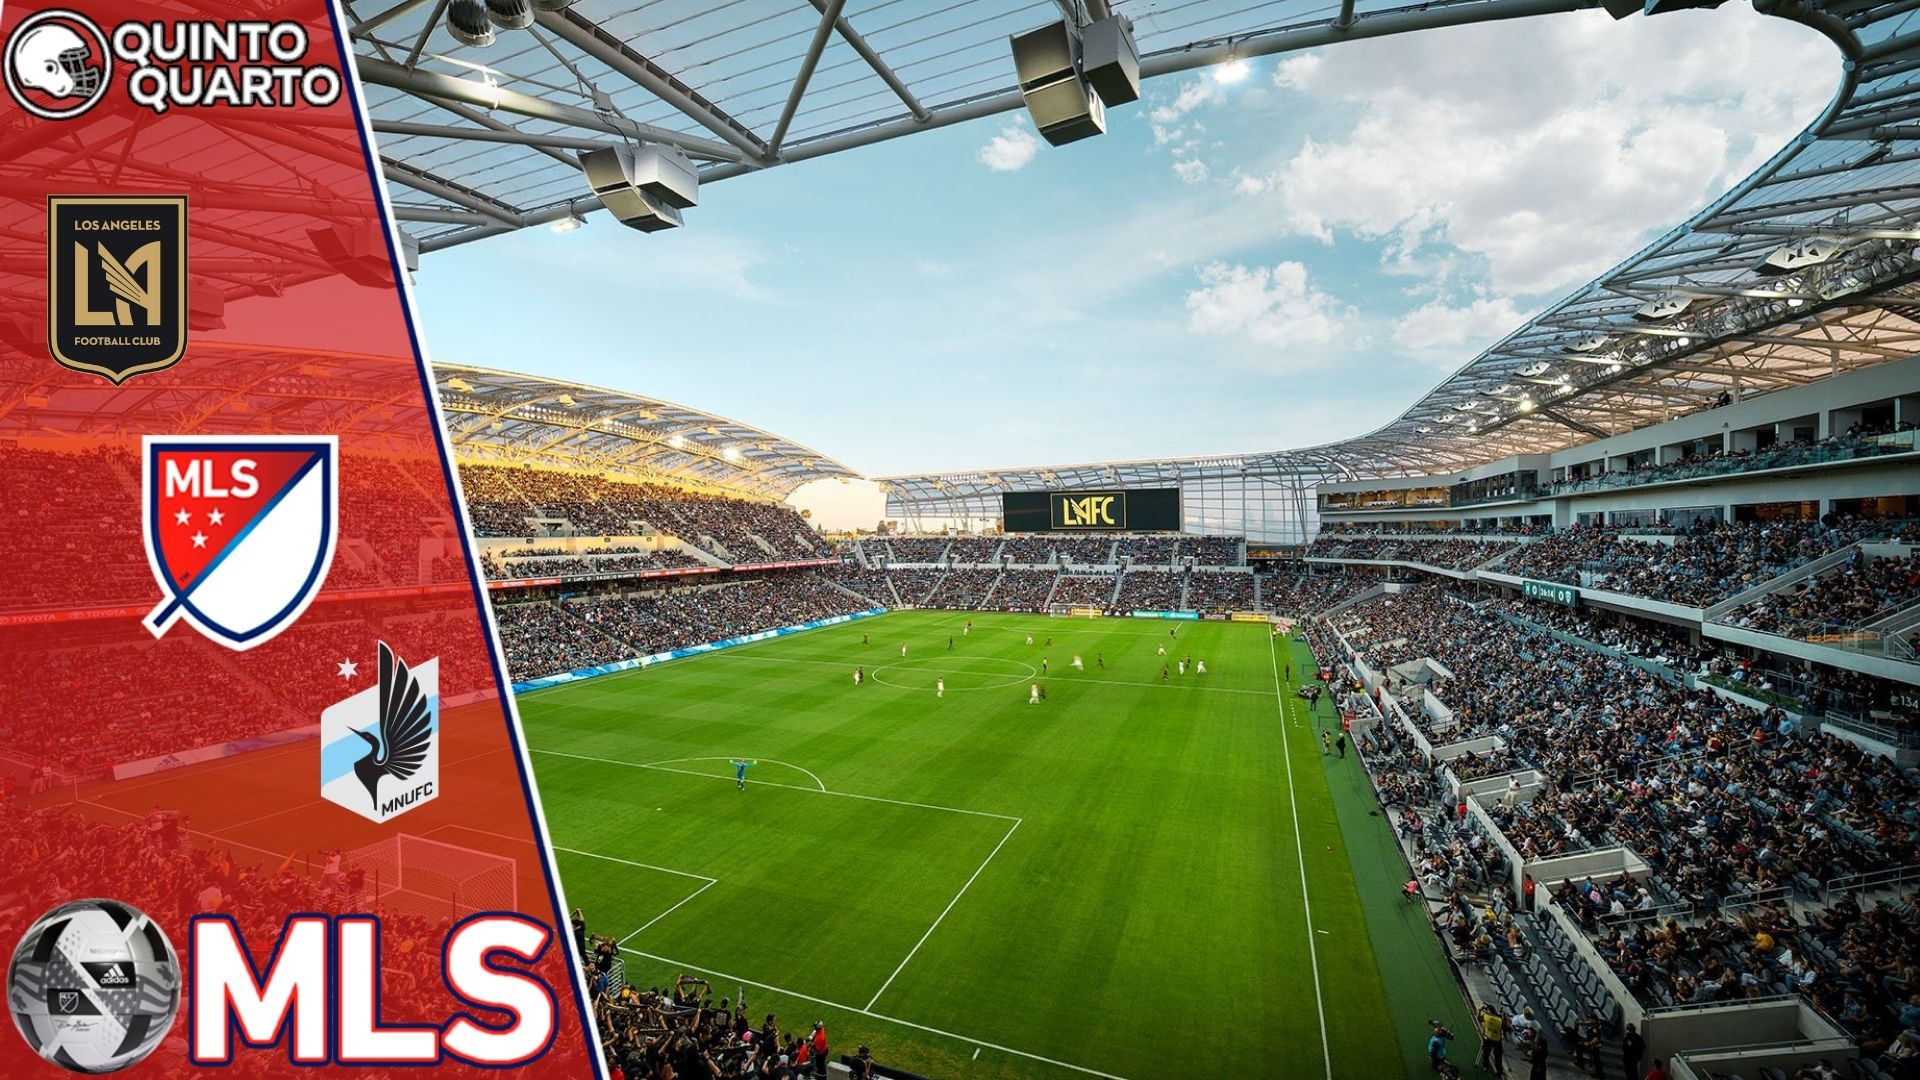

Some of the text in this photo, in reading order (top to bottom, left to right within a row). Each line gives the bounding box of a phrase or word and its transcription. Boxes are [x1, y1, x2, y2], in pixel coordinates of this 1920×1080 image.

[1063, 496, 1115, 525] LAFC
[13, 614, 57, 622] TOYOTA
[87, 609, 126, 617] TOYOTA
[1899, 695, 1919, 709] 134
